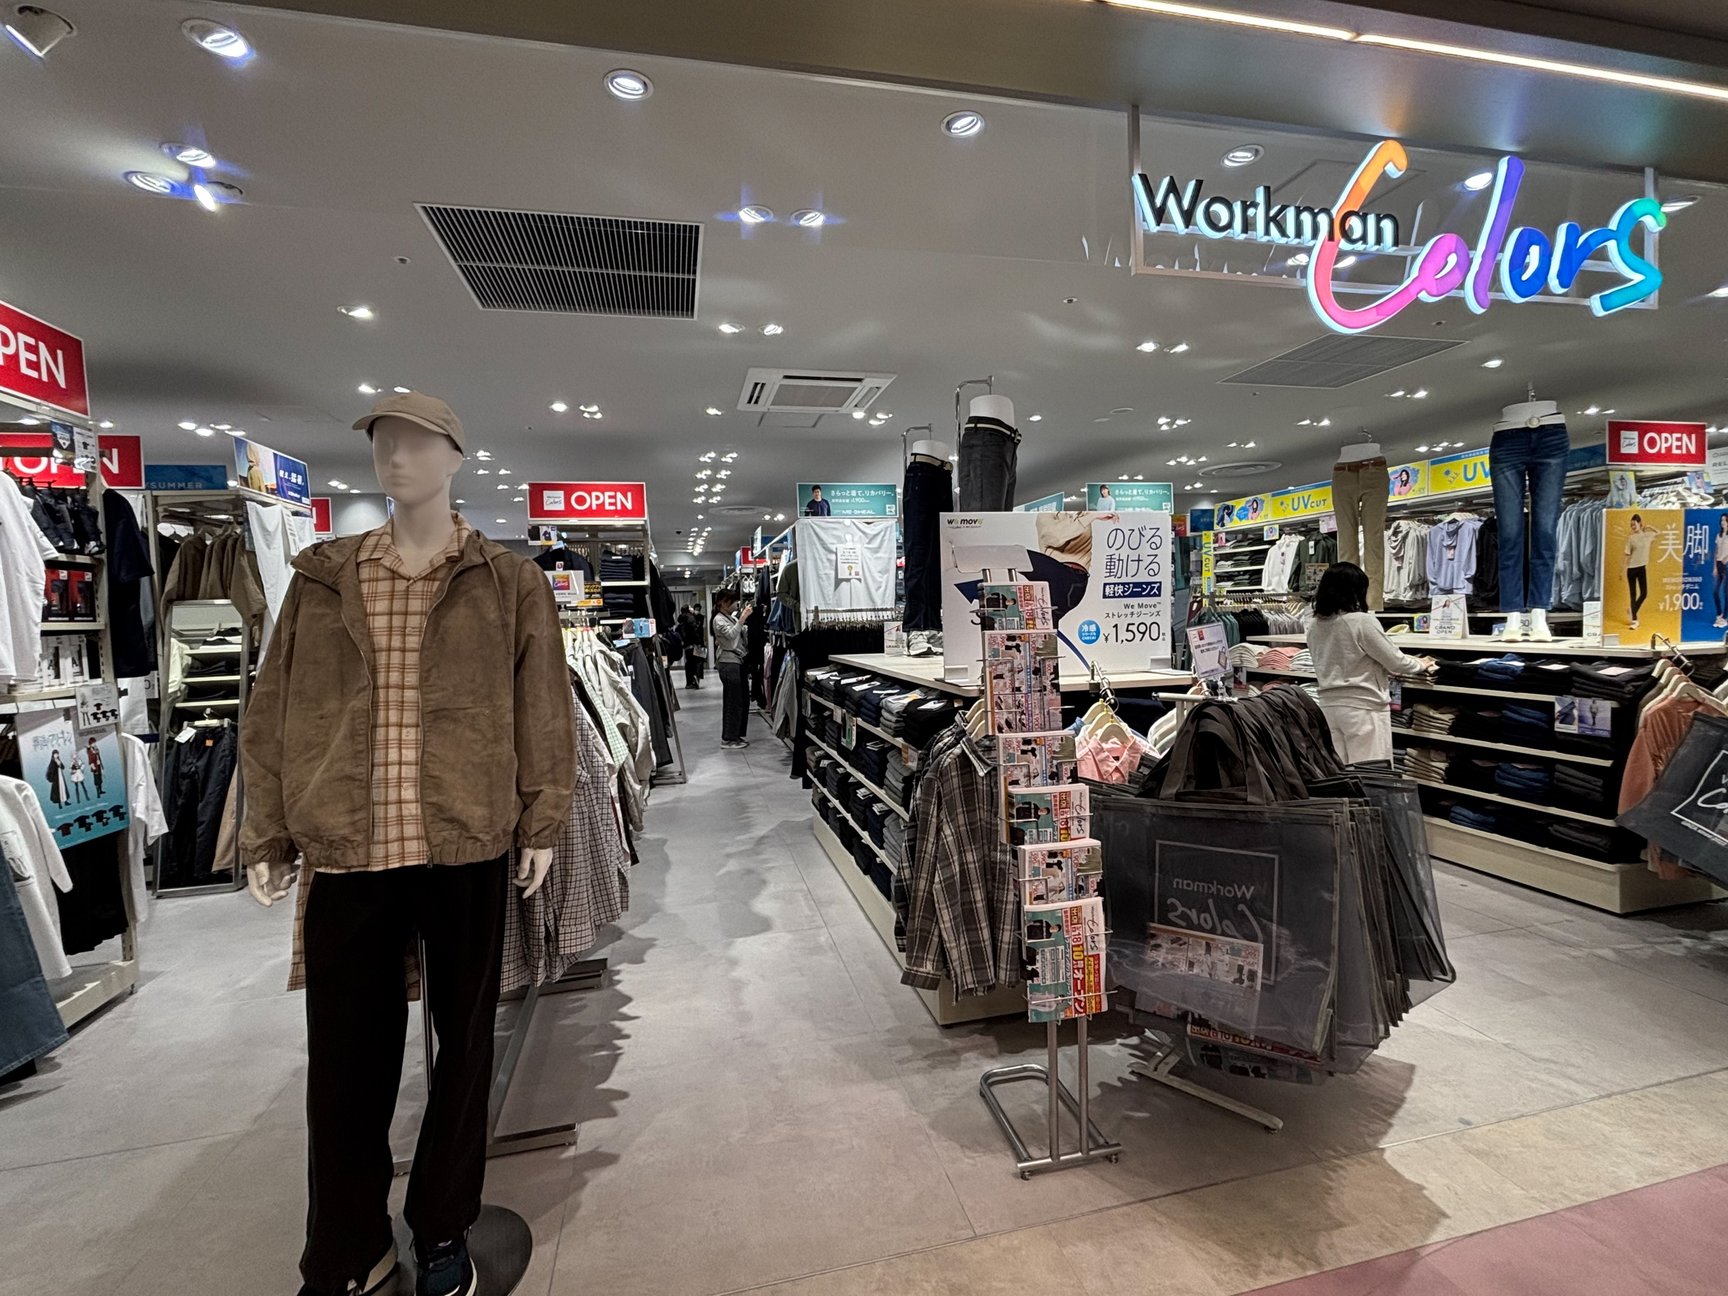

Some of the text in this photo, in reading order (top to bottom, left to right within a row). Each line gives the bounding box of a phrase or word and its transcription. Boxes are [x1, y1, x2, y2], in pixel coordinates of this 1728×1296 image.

[1133, 173, 1399, 252] Workman
[1307, 139, 1667, 333] Colors
[1643, 432, 1696, 454] OPEN
[150, 481, 203, 489] SUMMER
[570, 491, 633, 510] OPEN
[1291, 494, 1327, 511] UV CUT
[1106, 524, 1163, 551] のびる
[1657, 523, 1709, 564] 美脚
[1203, 541, 1212, 557] UV
[1104, 553, 1161, 579] 動ける
[1105, 583, 1160, 597] 軽快ジーンズ
[1104, 610, 1161, 619] ストレッチジーンズ
[1103, 621, 1161, 644] ¥1,590
[1072, 945, 1083, 960] 10
